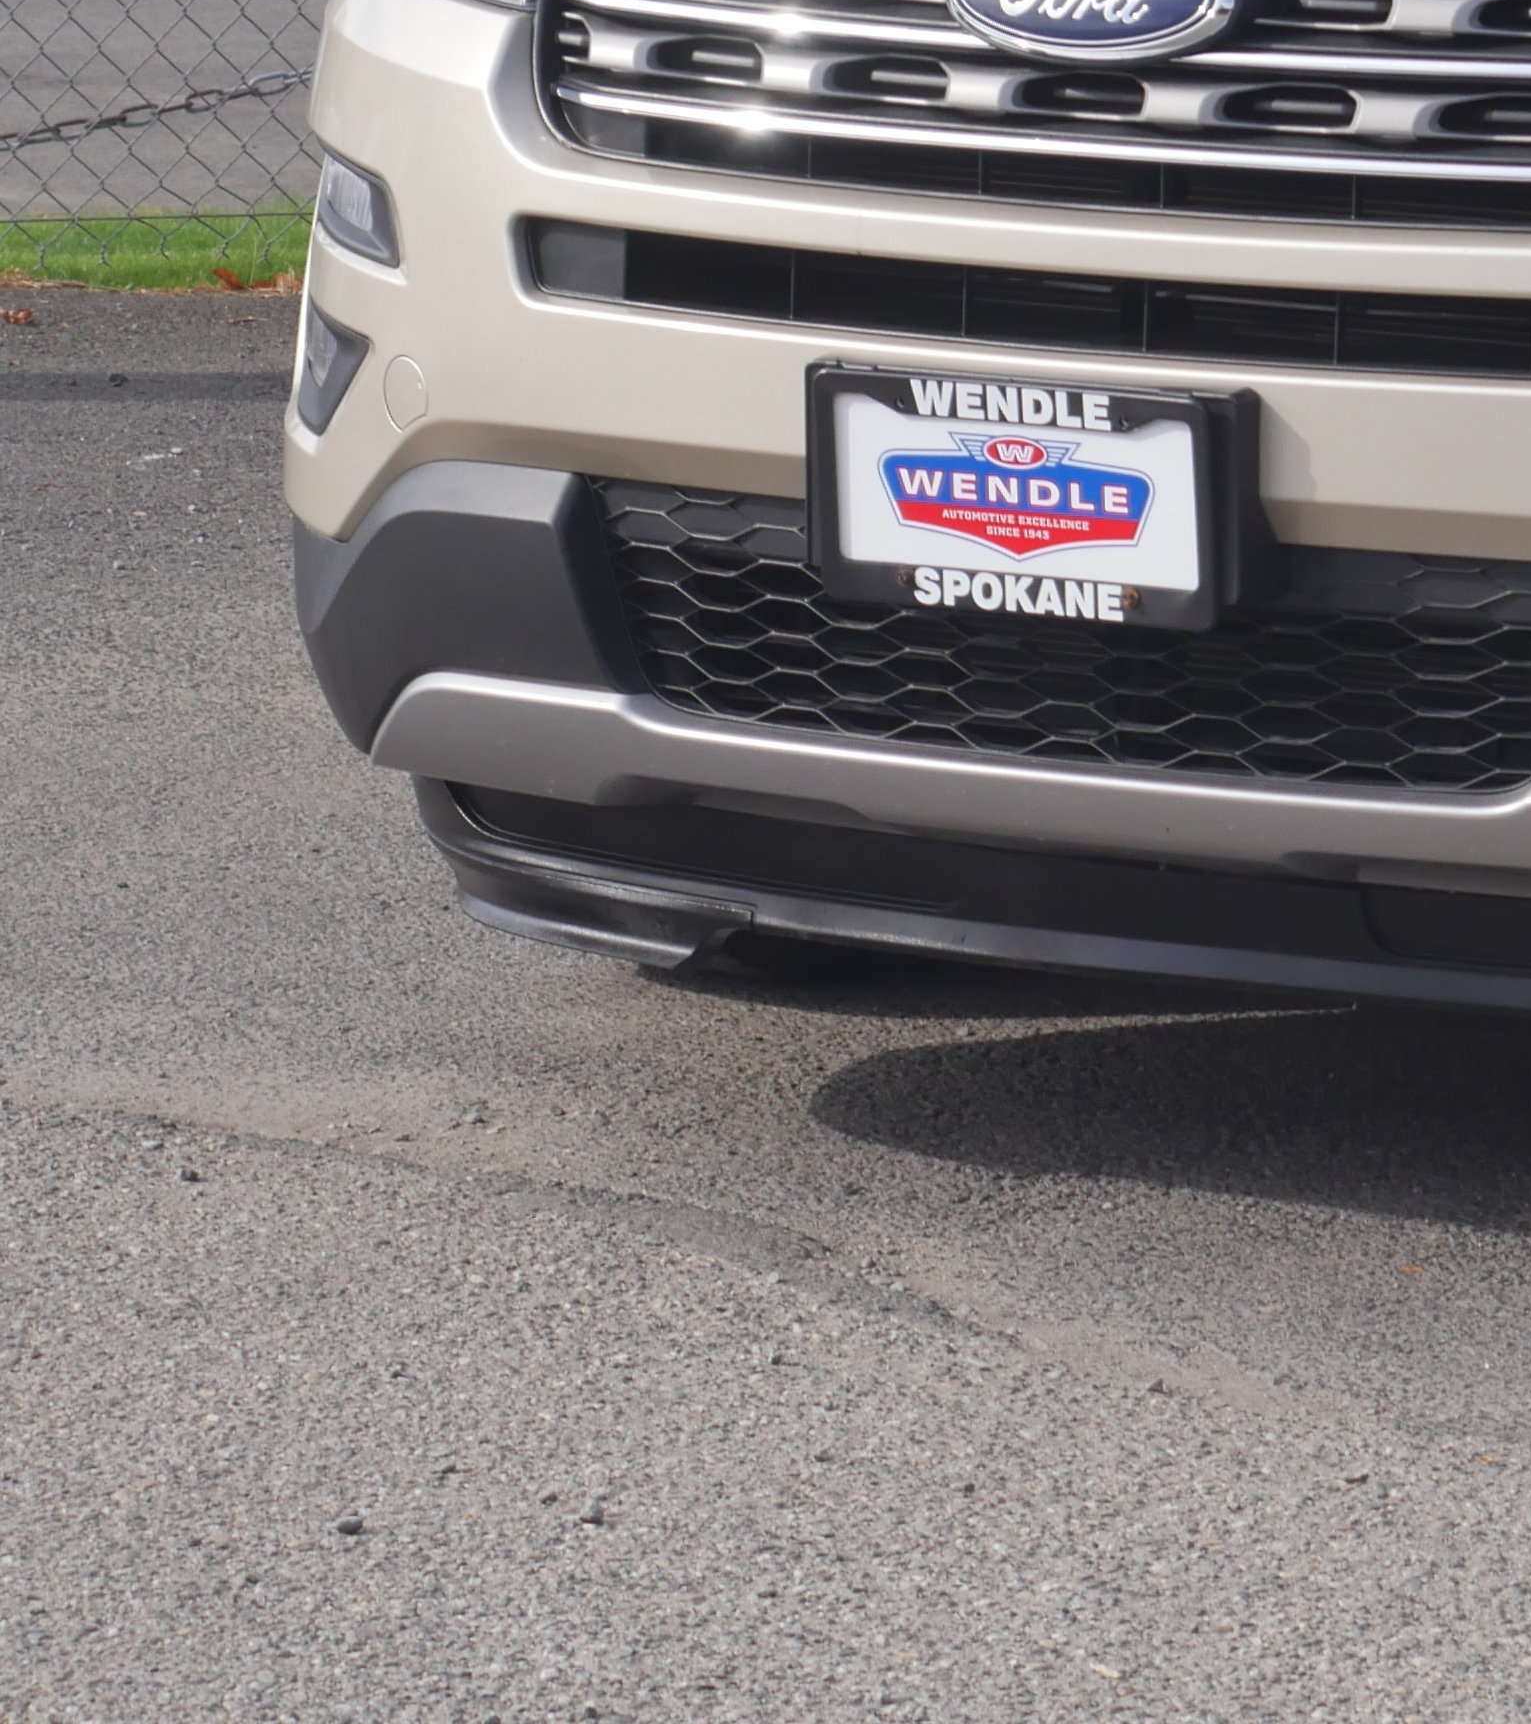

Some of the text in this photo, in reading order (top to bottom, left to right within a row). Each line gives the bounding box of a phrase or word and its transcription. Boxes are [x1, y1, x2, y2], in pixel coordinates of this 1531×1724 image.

[910, 378, 1112, 432] WENDLE
[898, 467, 1129, 514] WENDLE
[942, 508, 1090, 532] AUTOMOTIVE EXCELLENCE
[985, 525, 1050, 541] SINCE 1943
[913, 566, 1125, 623] SPOKANE
